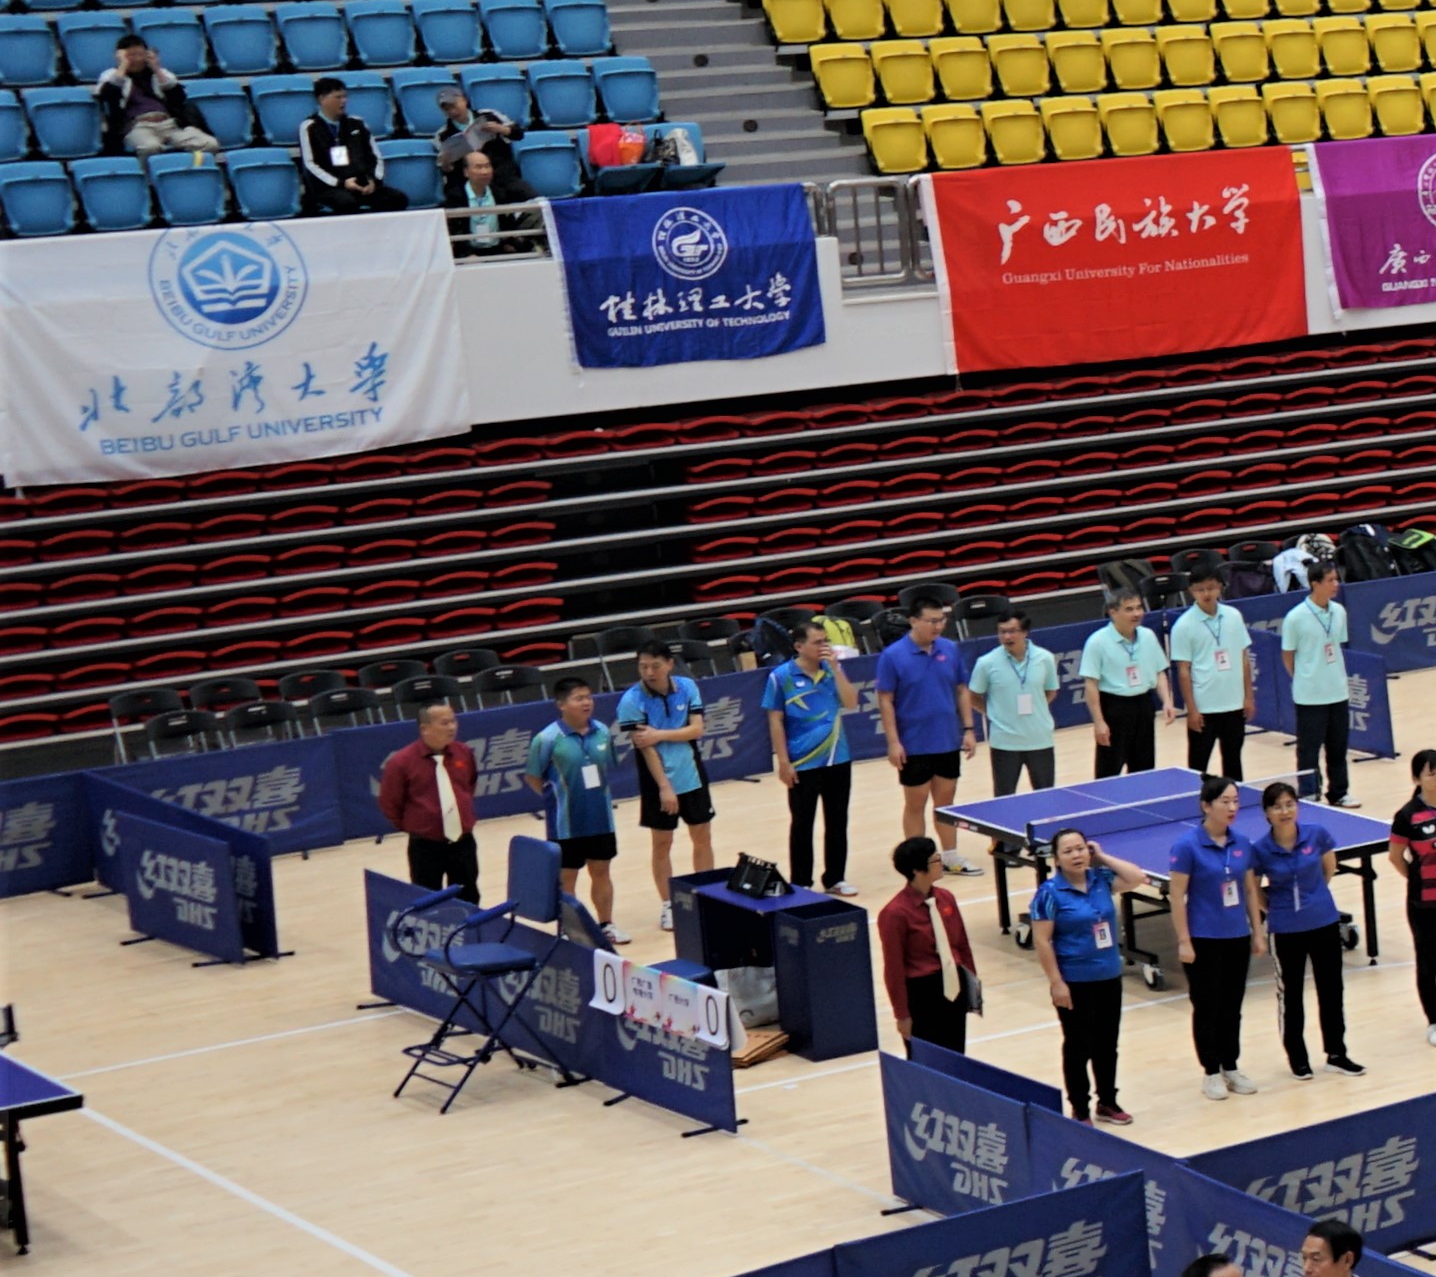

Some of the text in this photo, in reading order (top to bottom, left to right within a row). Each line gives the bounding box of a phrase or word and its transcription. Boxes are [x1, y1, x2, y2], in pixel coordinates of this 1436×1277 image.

[998, 183, 1250, 265] 广西民族大学
[1002, 253, 1250, 286] Guangxi University For Nationalities
[101, 405, 385, 456] BEIBU GULF UNIVERSITY
[905, 1101, 1009, 1173] 红双喜
[1248, 1138, 1420, 1208] 红双喜
